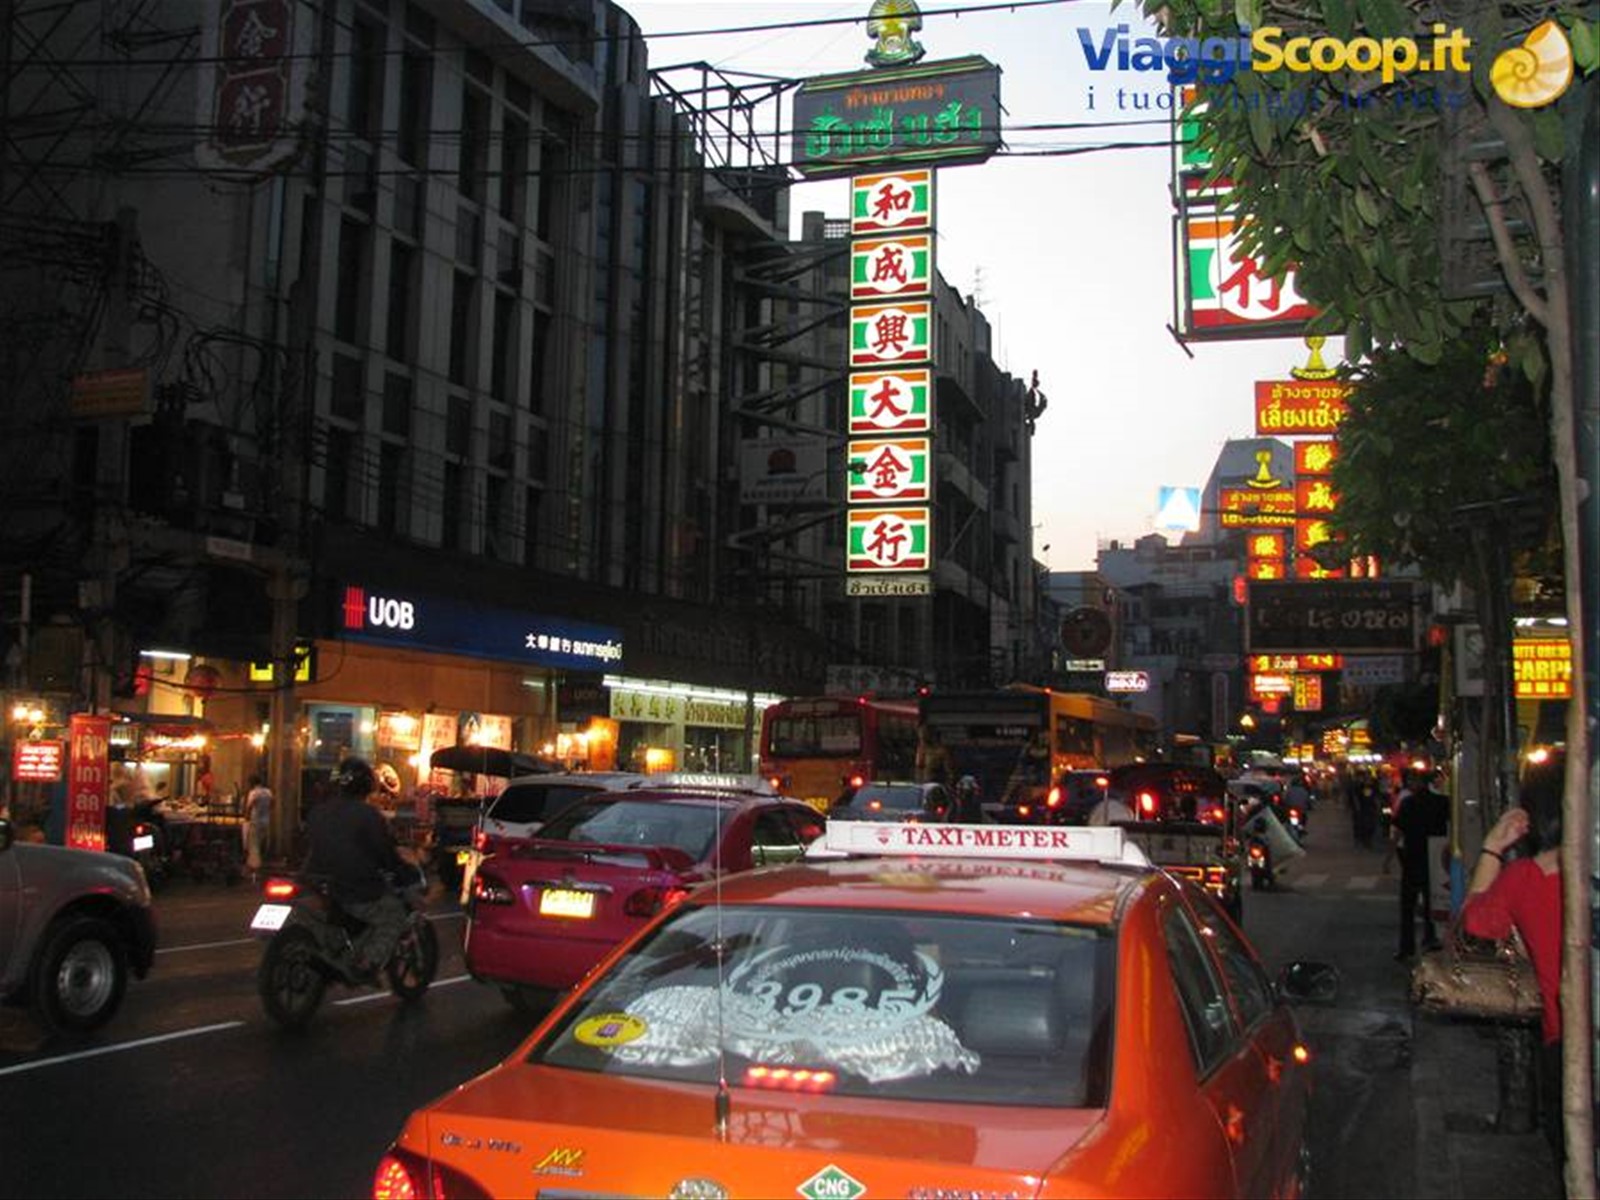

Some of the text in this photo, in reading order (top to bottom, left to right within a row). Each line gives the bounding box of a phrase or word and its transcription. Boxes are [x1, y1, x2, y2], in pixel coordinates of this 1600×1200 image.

[867, 184, 912, 563] 和成興大金行
[368, 595, 415, 631] UOB
[901, 826, 1070, 849] TAXI-METER
[814, 1177, 851, 1197] CNG
